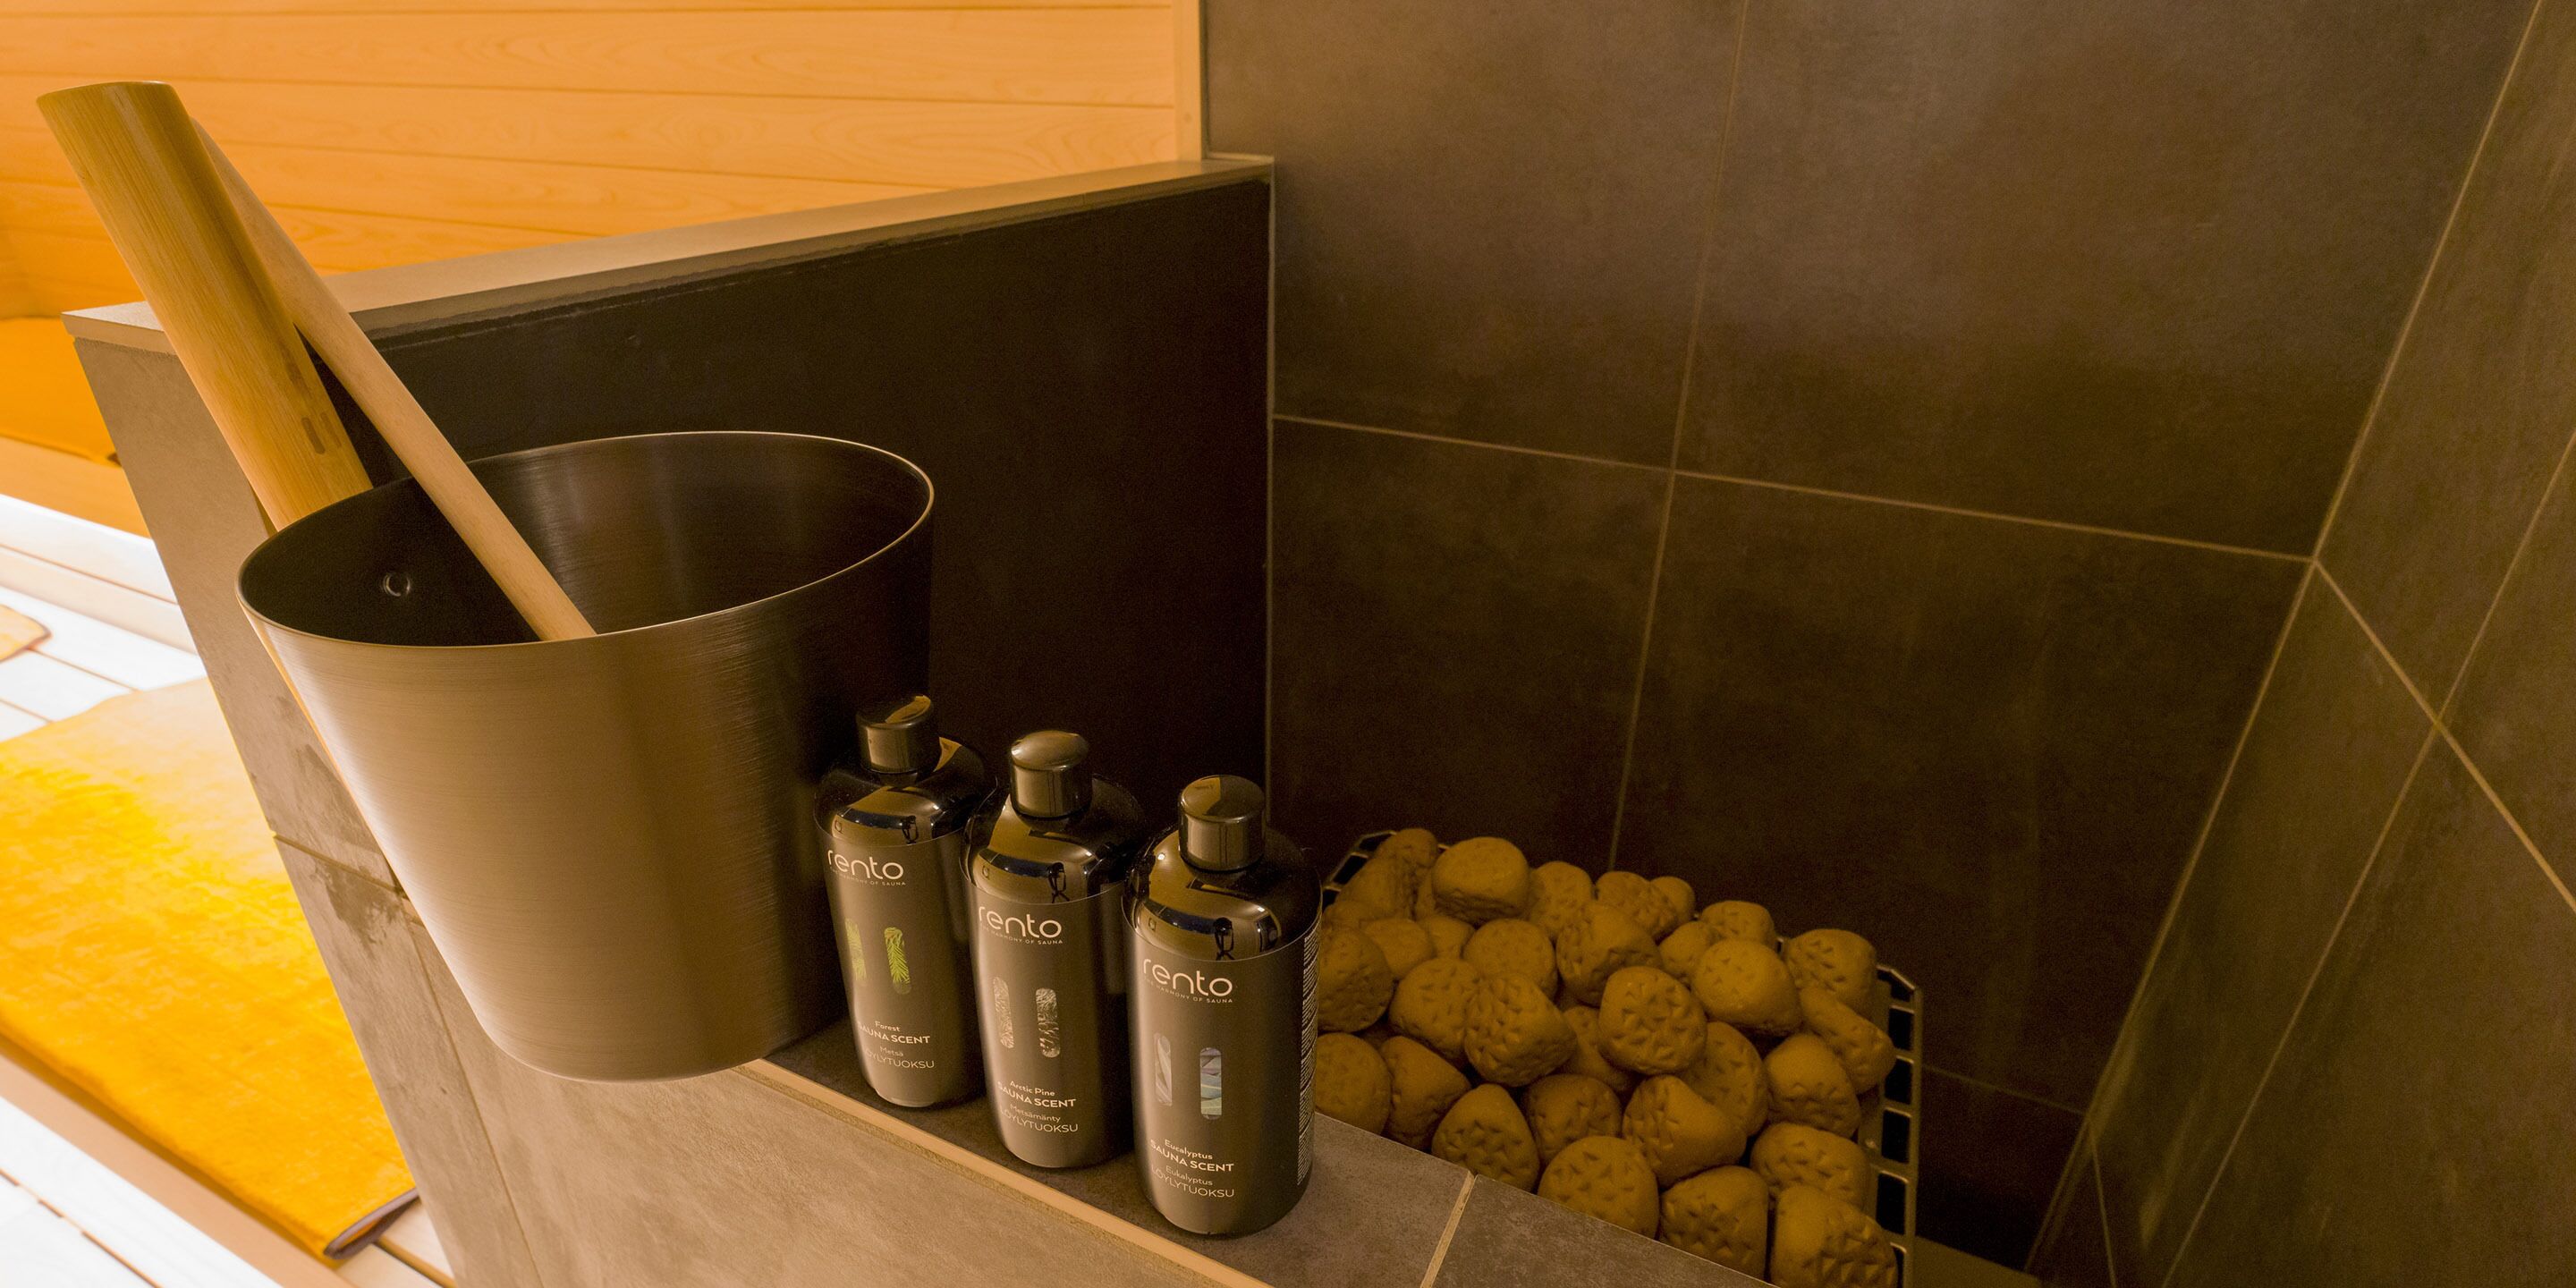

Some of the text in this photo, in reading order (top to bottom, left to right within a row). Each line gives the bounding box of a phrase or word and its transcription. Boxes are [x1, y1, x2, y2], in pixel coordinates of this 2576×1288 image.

[827, 850, 904, 879] rento
[979, 906, 1063, 938] rento
[1143, 958, 1233, 996] rento
[875, 1021, 901, 1032] Forest
[891, 1034, 930, 1044] SCENT
[1010, 1080, 1055, 1097] Arctic Pine
[1034, 1097, 1077, 1108] SCENT
[1150, 1139, 1234, 1172] SAUNA SCENT
[1165, 1139, 1213, 1160] Eucalyptus
[1165, 1165, 1214, 1186] Eukalyptus
